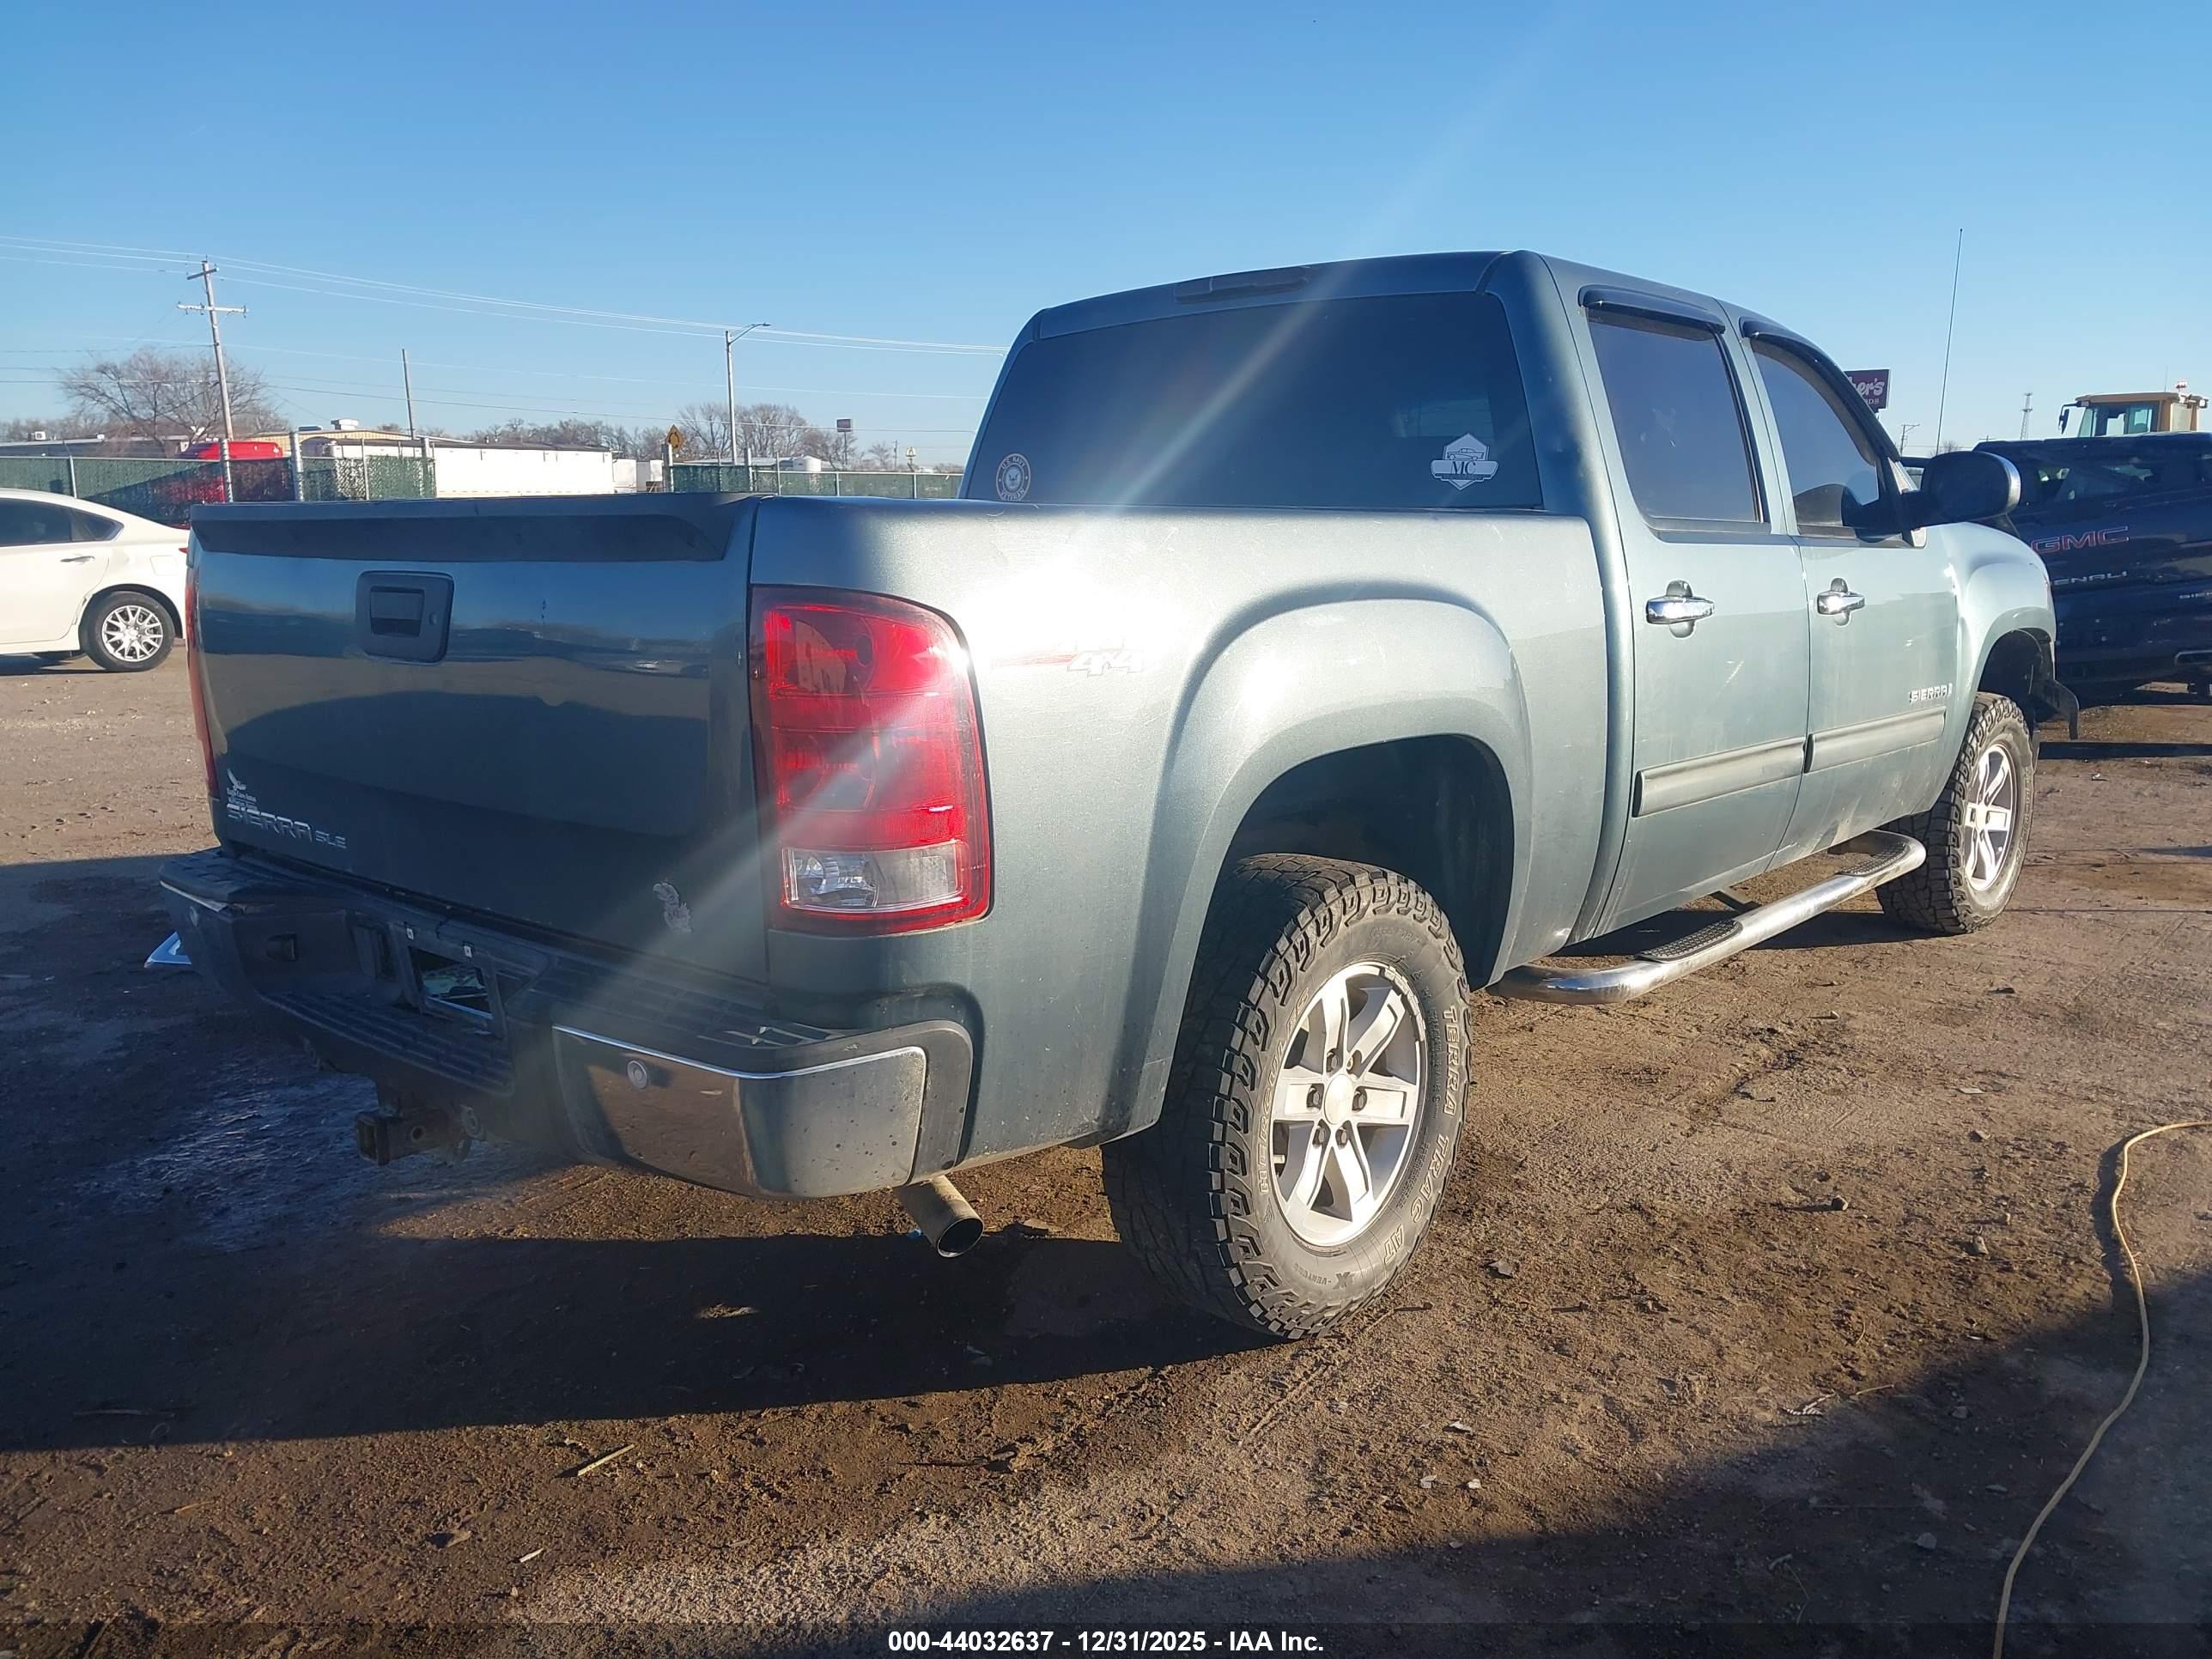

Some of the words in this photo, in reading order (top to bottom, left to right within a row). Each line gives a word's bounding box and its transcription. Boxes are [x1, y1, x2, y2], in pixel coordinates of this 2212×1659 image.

[2030, 526, 2130, 555] GMC
[2051, 571, 2128, 586] ENALI
[1908, 684, 1949, 704] SIERRA
[227, 803, 313, 842] SIERRA
[315, 830, 347, 849] SLE
[1443, 1006, 1460, 1116] TERRA
[1411, 1133, 1449, 1224] TRAC
